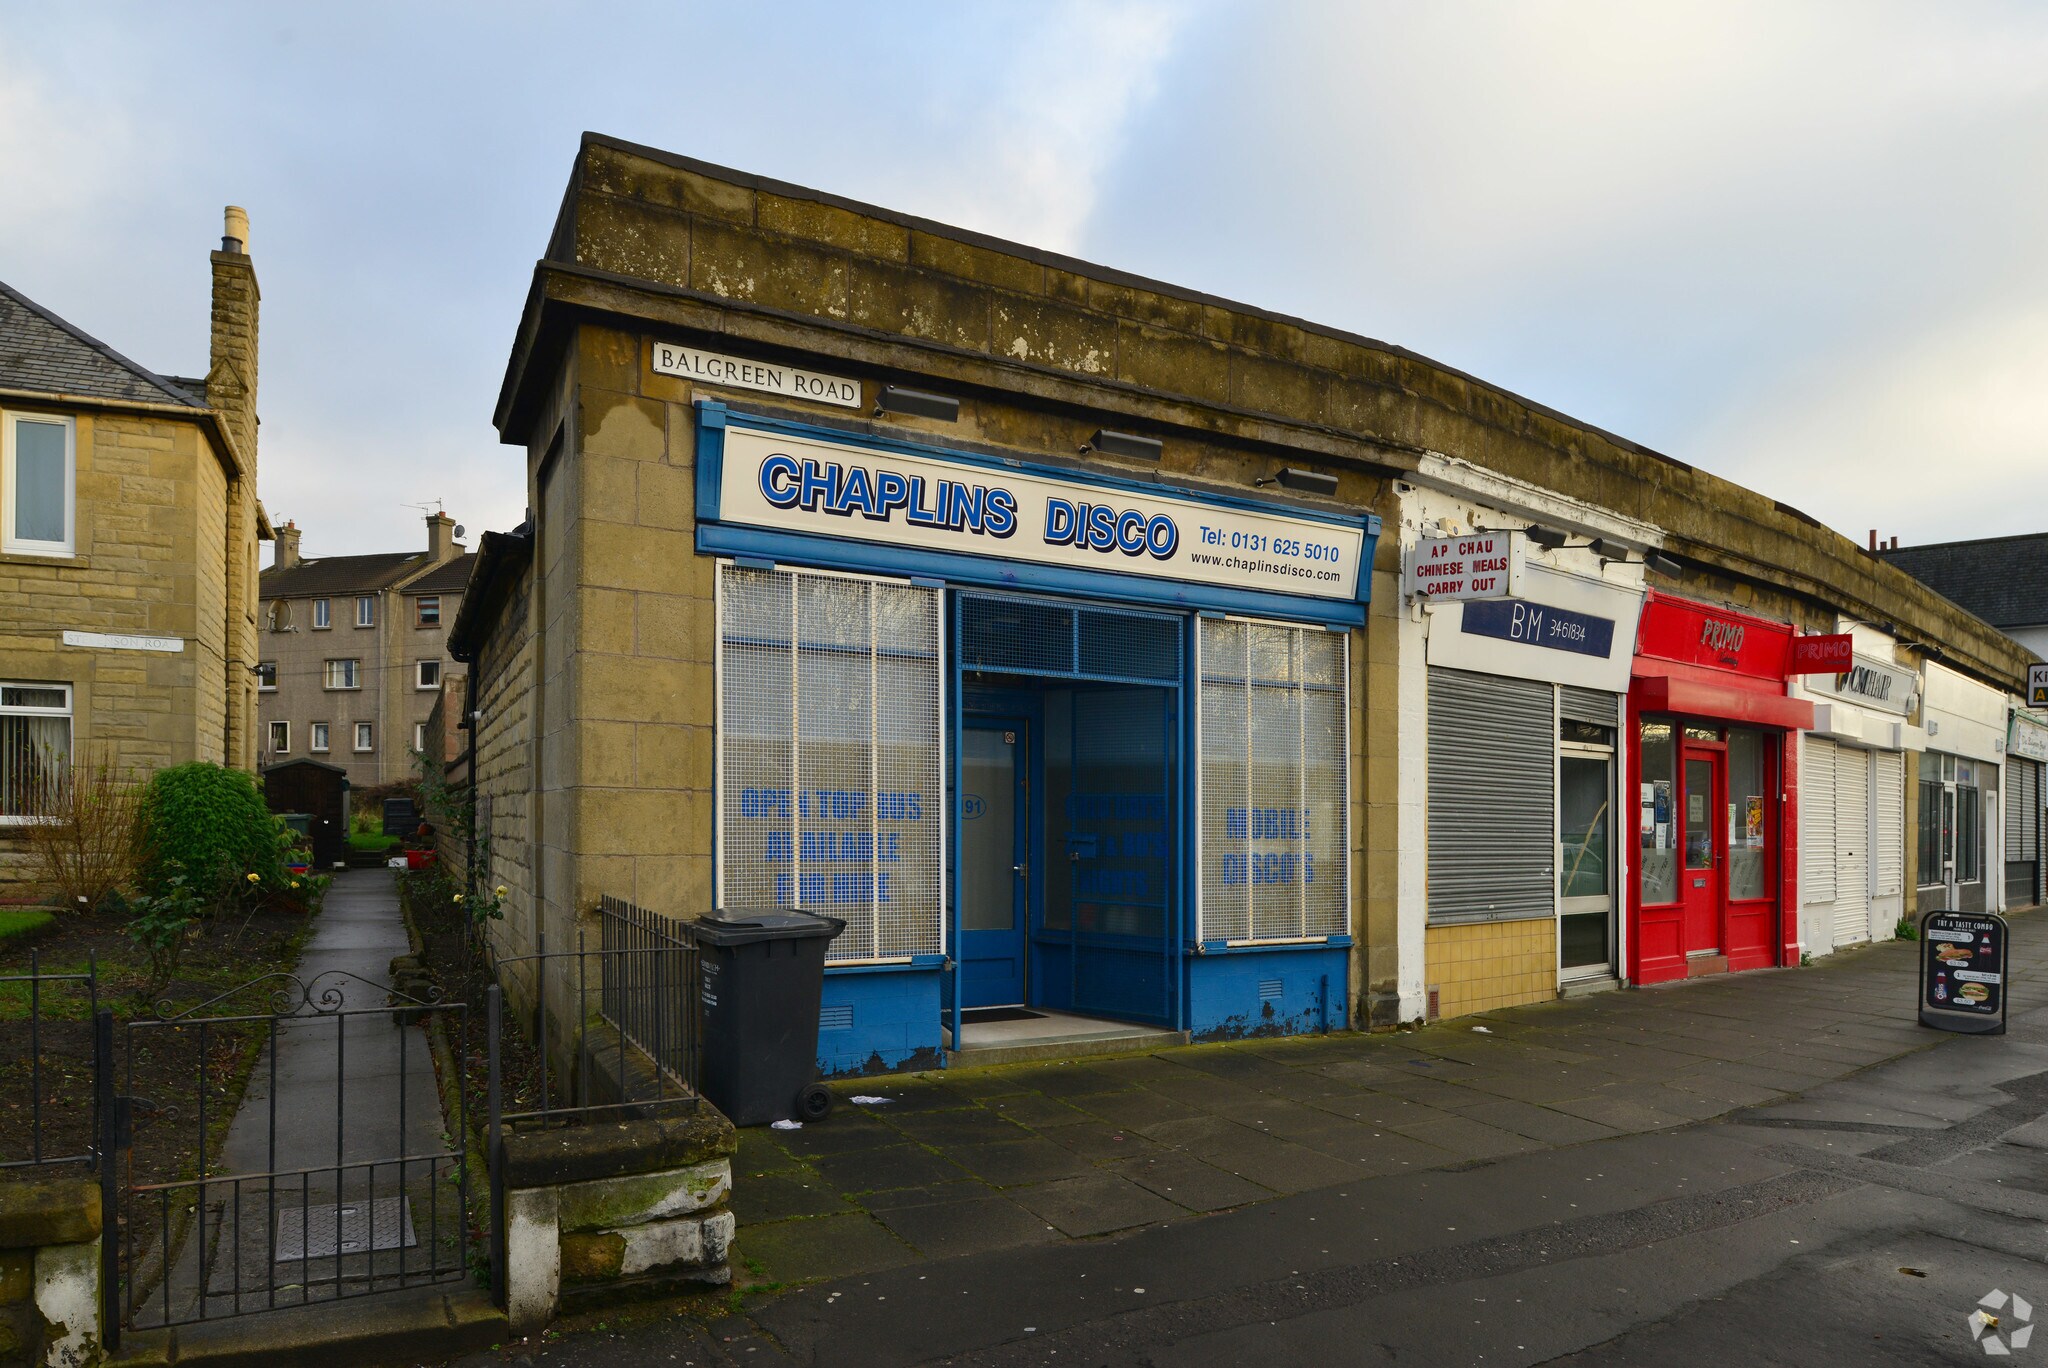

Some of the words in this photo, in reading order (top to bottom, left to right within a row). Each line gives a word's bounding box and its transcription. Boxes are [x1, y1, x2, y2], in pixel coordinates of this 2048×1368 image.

[661, 349, 783, 389] BALGREEN
[795, 374, 855, 401] ROAD
[758, 453, 1018, 539] CHAPLINS
[1043, 497, 1180, 561] DISCO
[1199, 526, 1226, 546] Tel:
[1231, 531, 1267, 552] 0131
[1273, 538, 1300, 557] 625
[1304, 543, 1339, 563] 5010
[1459, 540, 1494, 556] CHAU
[1191, 553, 1341, 582] www.chaplinsdisco.com
[1417, 561, 1463, 577] CHINESE
[1473, 557, 1507, 573] MEALS
[1427, 580, 1464, 595] CARRY
[1472, 577, 1496, 591] OUT
[1510, 602, 1543, 642] BM
[1550, 618, 1586, 642] 3461834
[1700, 618, 1745, 651] PRIMO
[1797, 641, 1850, 660] PRIMO
[815, 789, 867, 821] TOP
[1227, 807, 1313, 841] MOBILE
